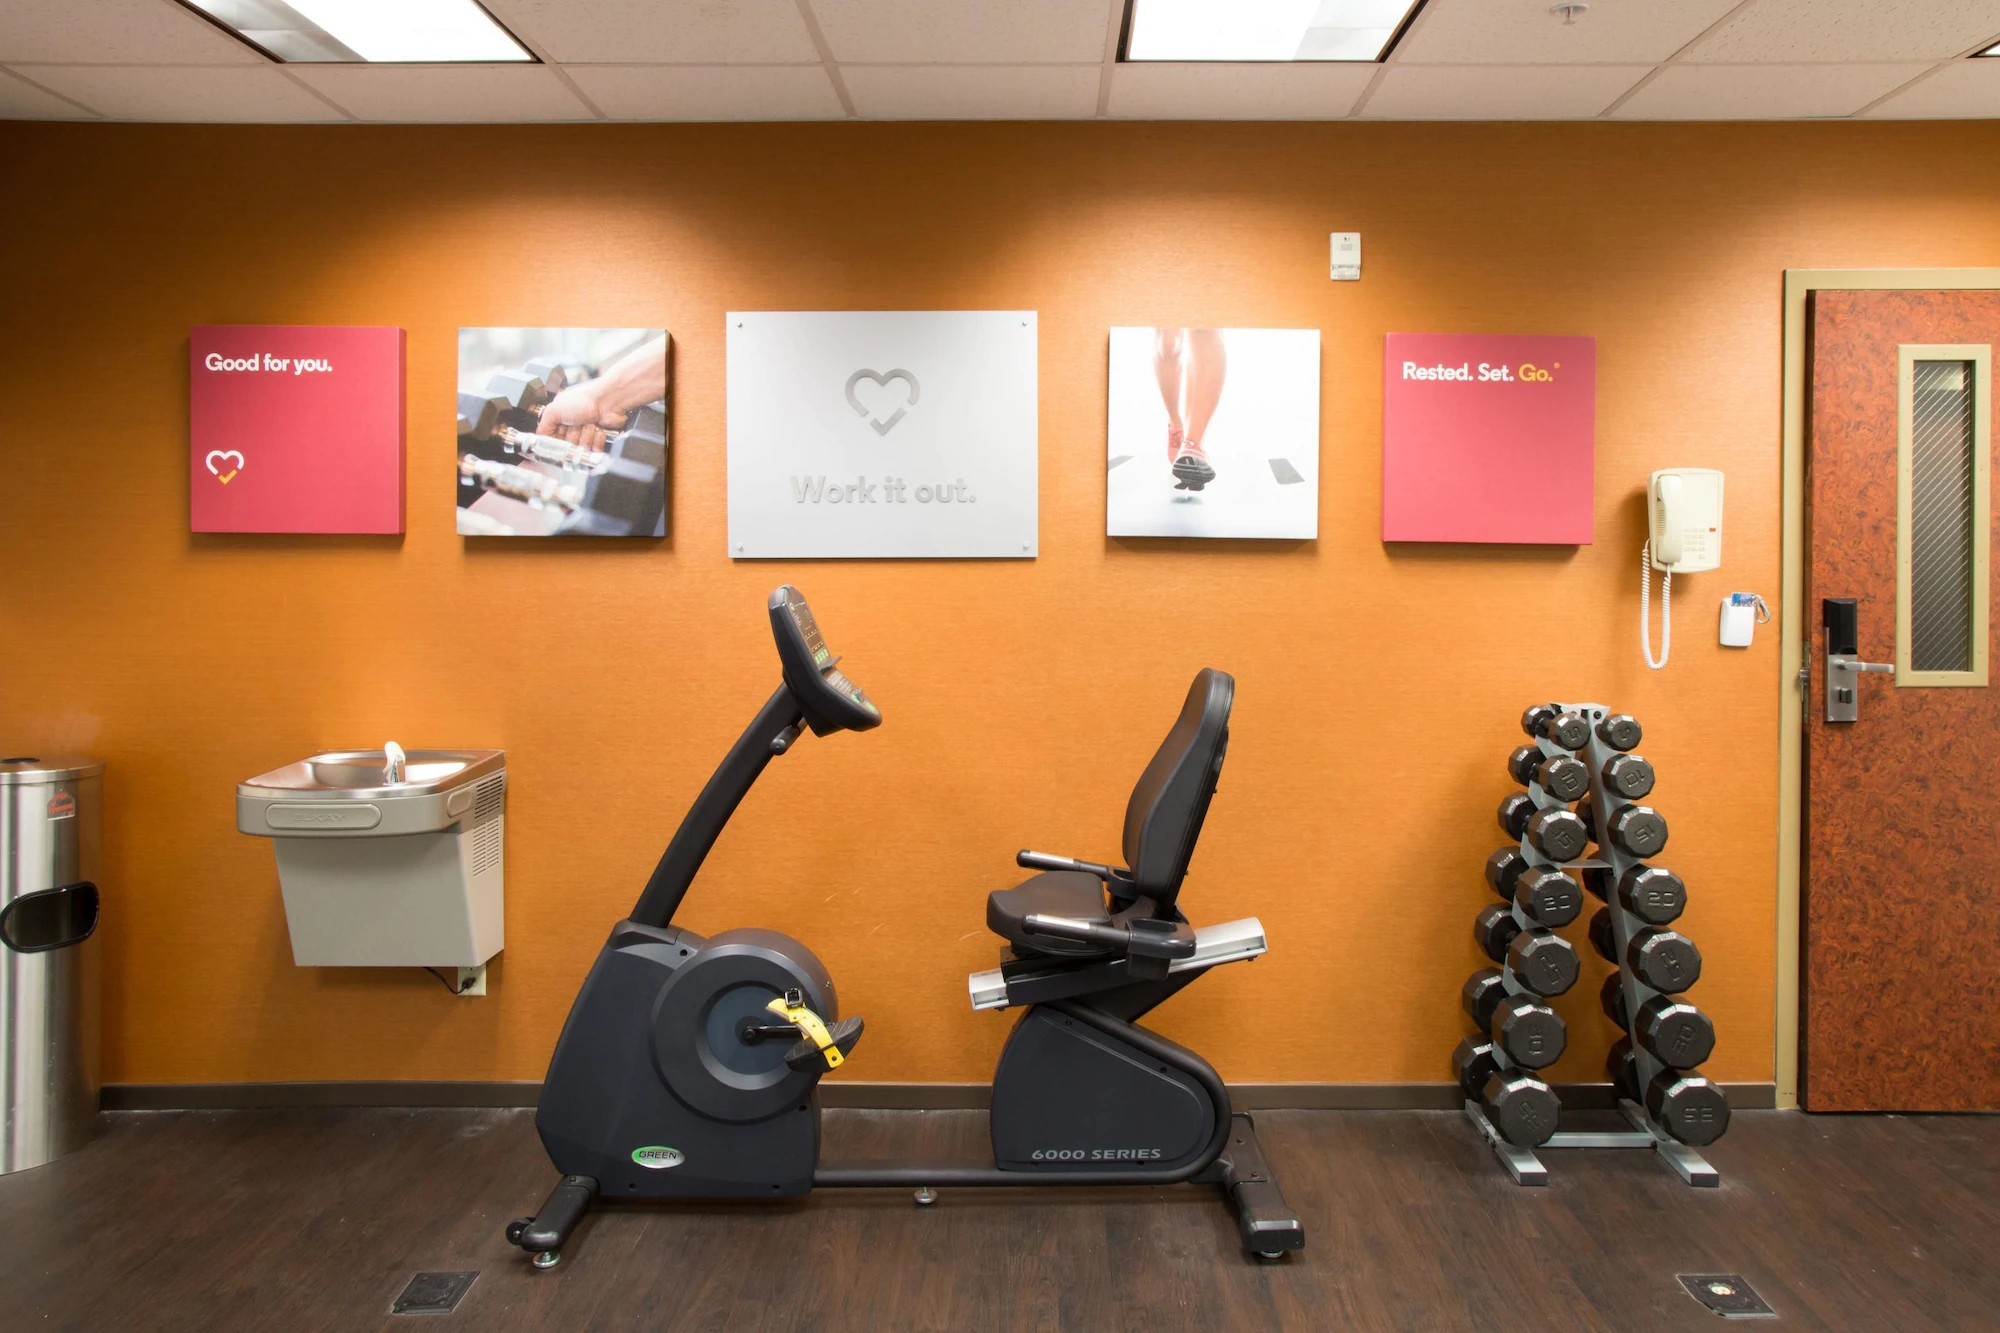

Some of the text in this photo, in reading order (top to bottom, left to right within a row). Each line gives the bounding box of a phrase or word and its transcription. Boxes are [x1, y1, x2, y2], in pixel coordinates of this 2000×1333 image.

[205, 353, 333, 376] Good for you.
[1402, 361, 1474, 381] Rested.
[1477, 362, 1514, 382] Set.
[790, 475, 977, 504] Work it out.
[1624, 768, 1646, 788] 10
[293, 812, 348, 822] ELKAY
[1648, 890, 1676, 907] 20
[639, 1150, 677, 1160] GREEN
[1031, 1148, 1161, 1160] 6000 SERIES
